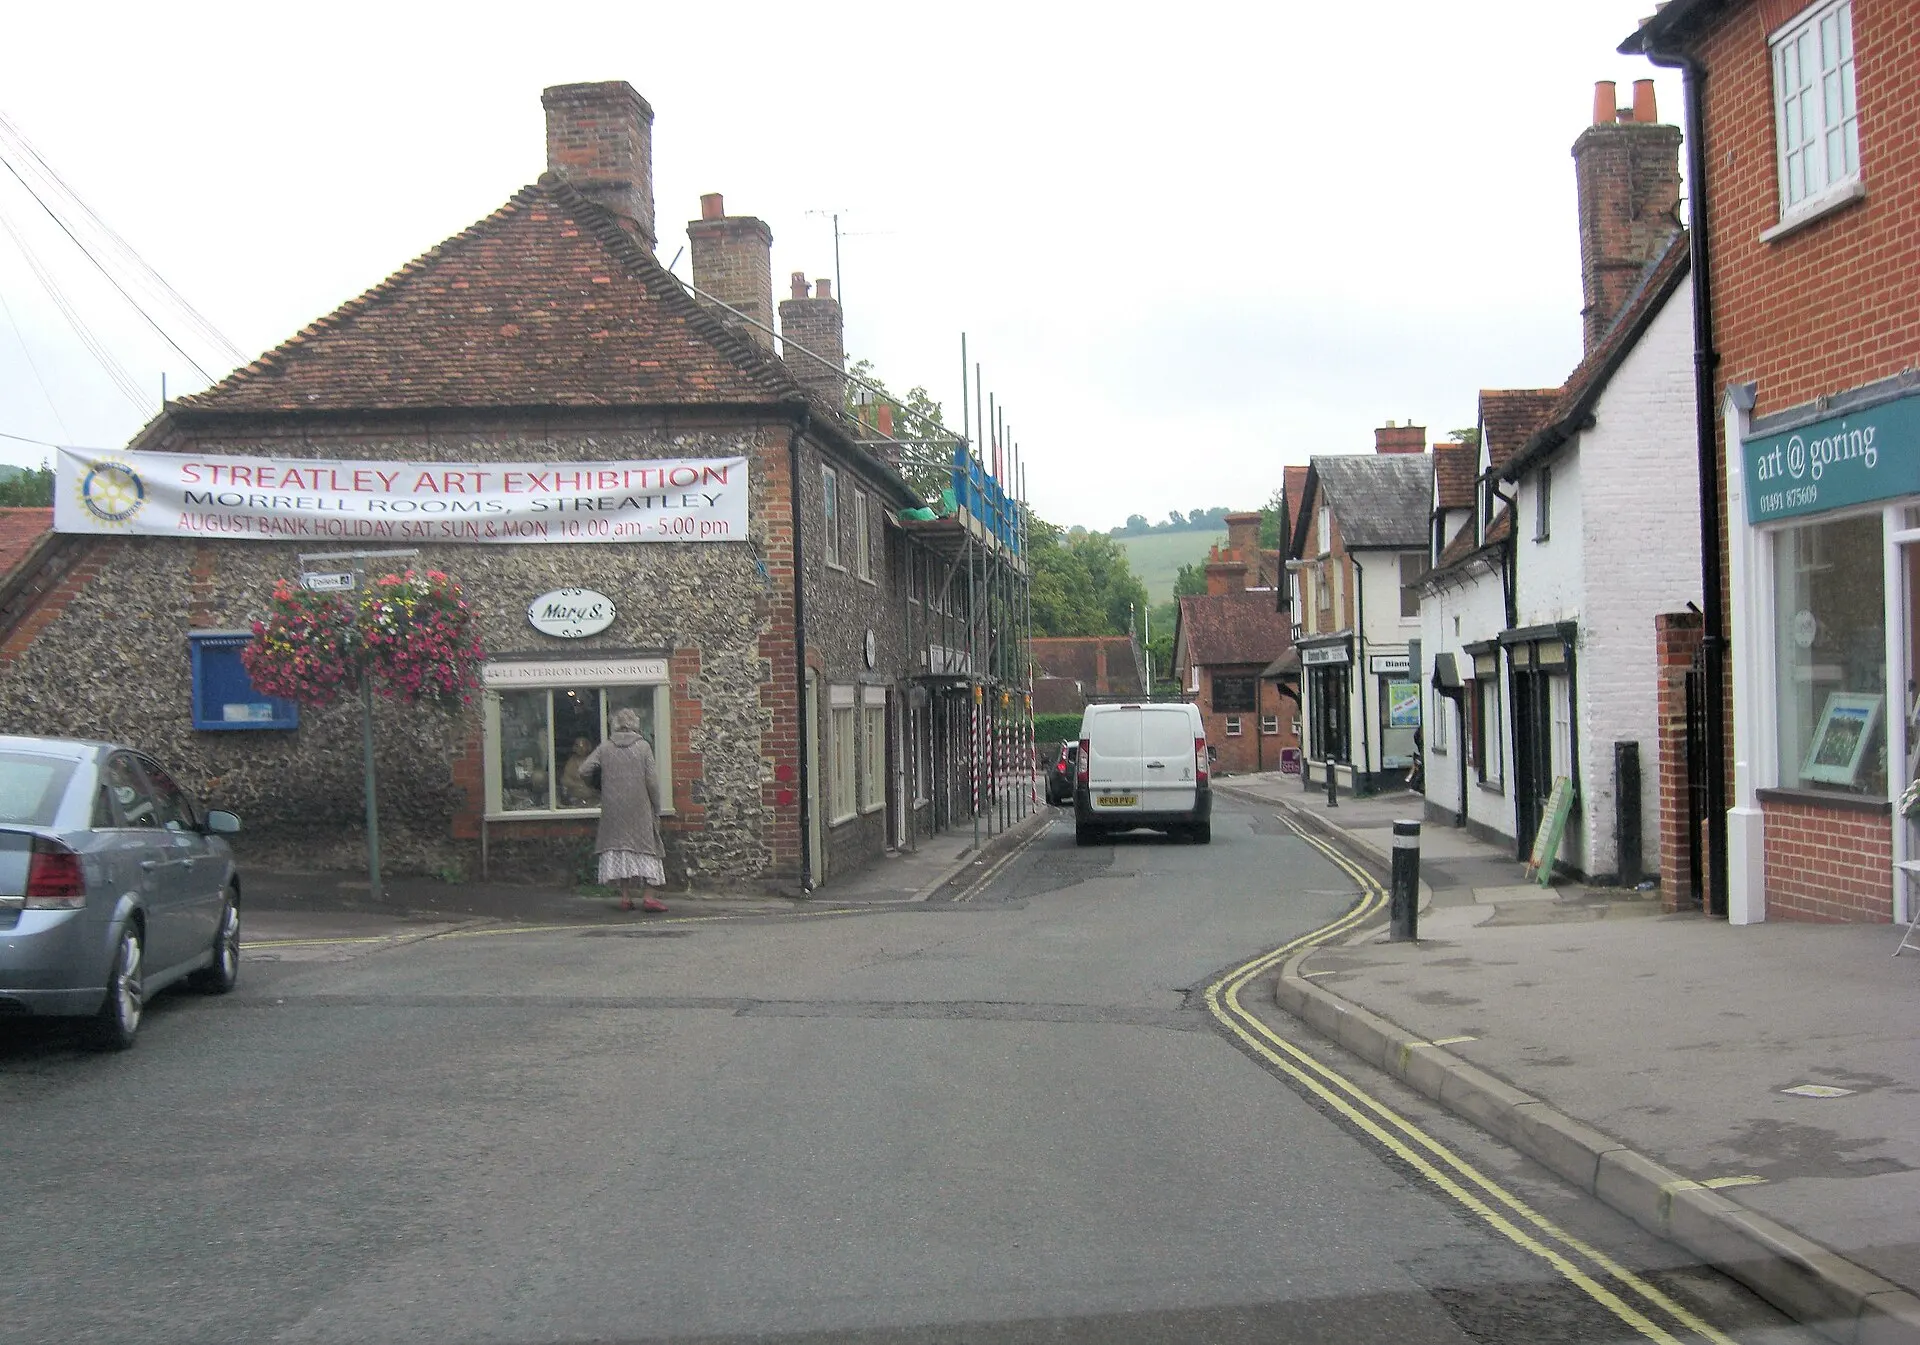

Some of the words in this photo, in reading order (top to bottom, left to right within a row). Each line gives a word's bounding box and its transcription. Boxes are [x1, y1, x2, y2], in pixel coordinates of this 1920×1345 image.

[1758, 444, 1783, 481] art
[1786, 434, 1806, 479] @
[1810, 421, 1878, 481] goring
[180, 463, 400, 493] STREATLEY
[413, 470, 491, 494] ART
[504, 465, 729, 494] EXHIBITION
[183, 490, 354, 513] MORRELL
[368, 499, 512, 514] ROOMS,
[531, 492, 724, 513] STREATLEY
[1760, 491, 1784, 513] 01491
[177, 512, 254, 533] AUGUST
[258, 516, 309, 535] BANK
[313, 517, 398, 538] HOLIDAY
[440, 519, 479, 539] SUN
[484, 520, 498, 537] &
[502, 518, 548, 539] MON
[559, 518, 610, 538] 10.00
[613, 519, 642, 537] am
[657, 515, 696, 536] 5.00
[699, 518, 730, 538] pm
[541, 603, 588, 624] Mary
[518, 667, 573, 678] INTERIOR
[574, 666, 614, 676] DESIGN
[616, 664, 663, 675] SERVICE
